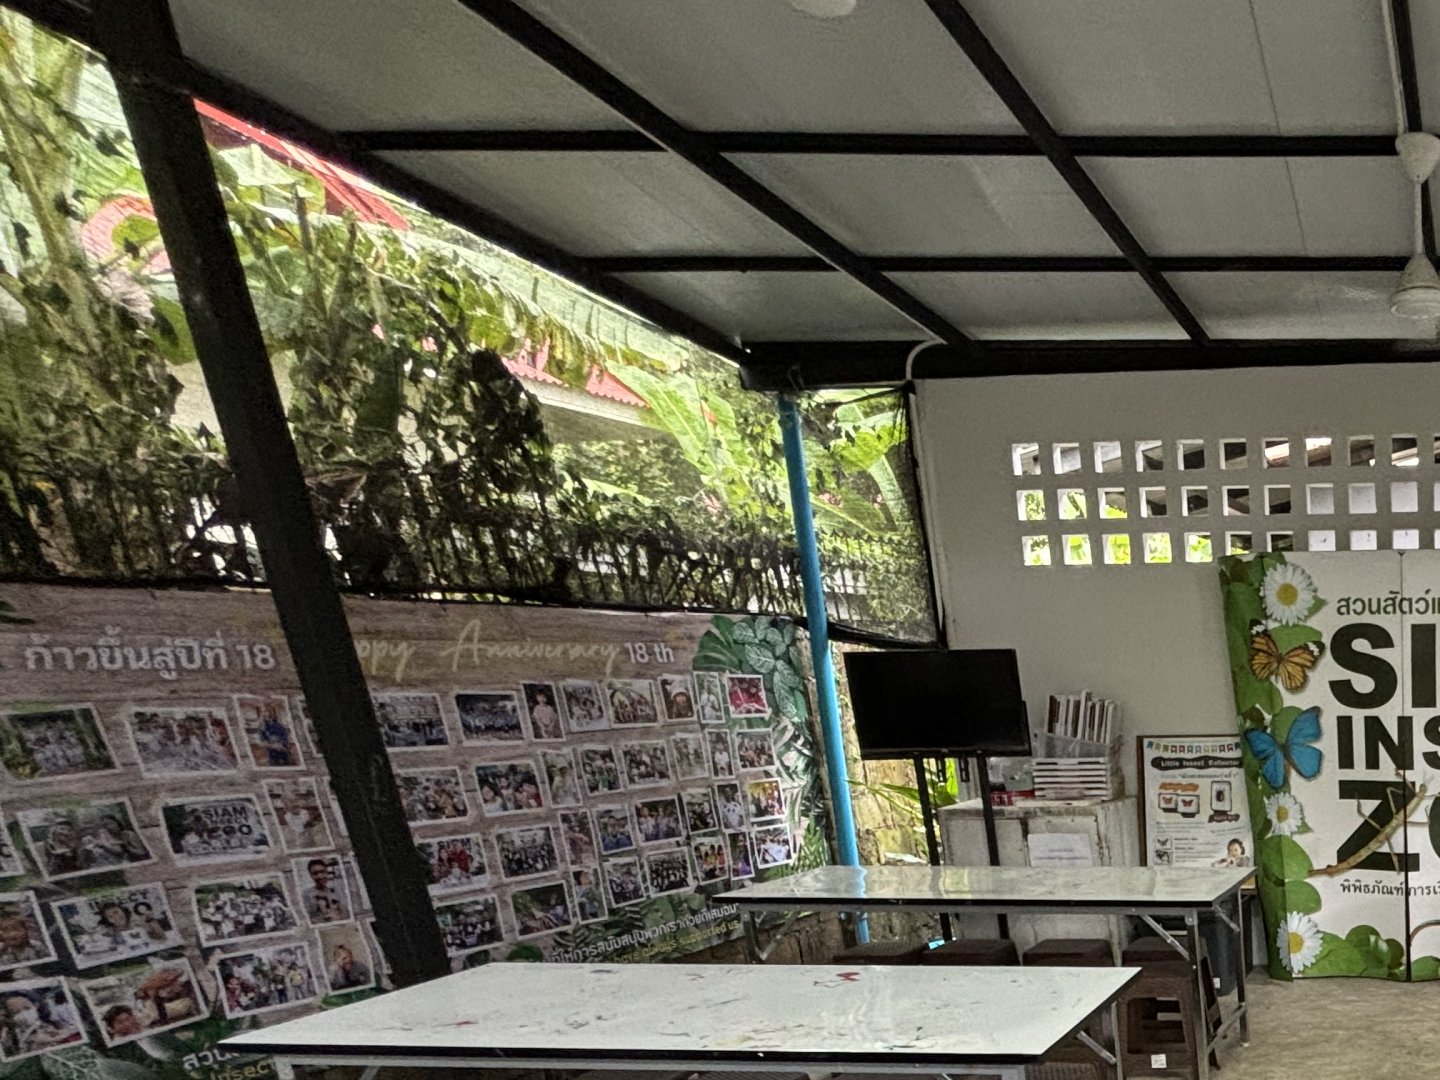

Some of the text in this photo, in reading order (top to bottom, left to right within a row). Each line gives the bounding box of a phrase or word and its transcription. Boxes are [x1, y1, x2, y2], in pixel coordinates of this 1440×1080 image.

[235, 644, 276, 670] 18
[624, 642, 650, 665] 18
[653, 642, 675, 664] th
[728, 919, 740, 931] us
